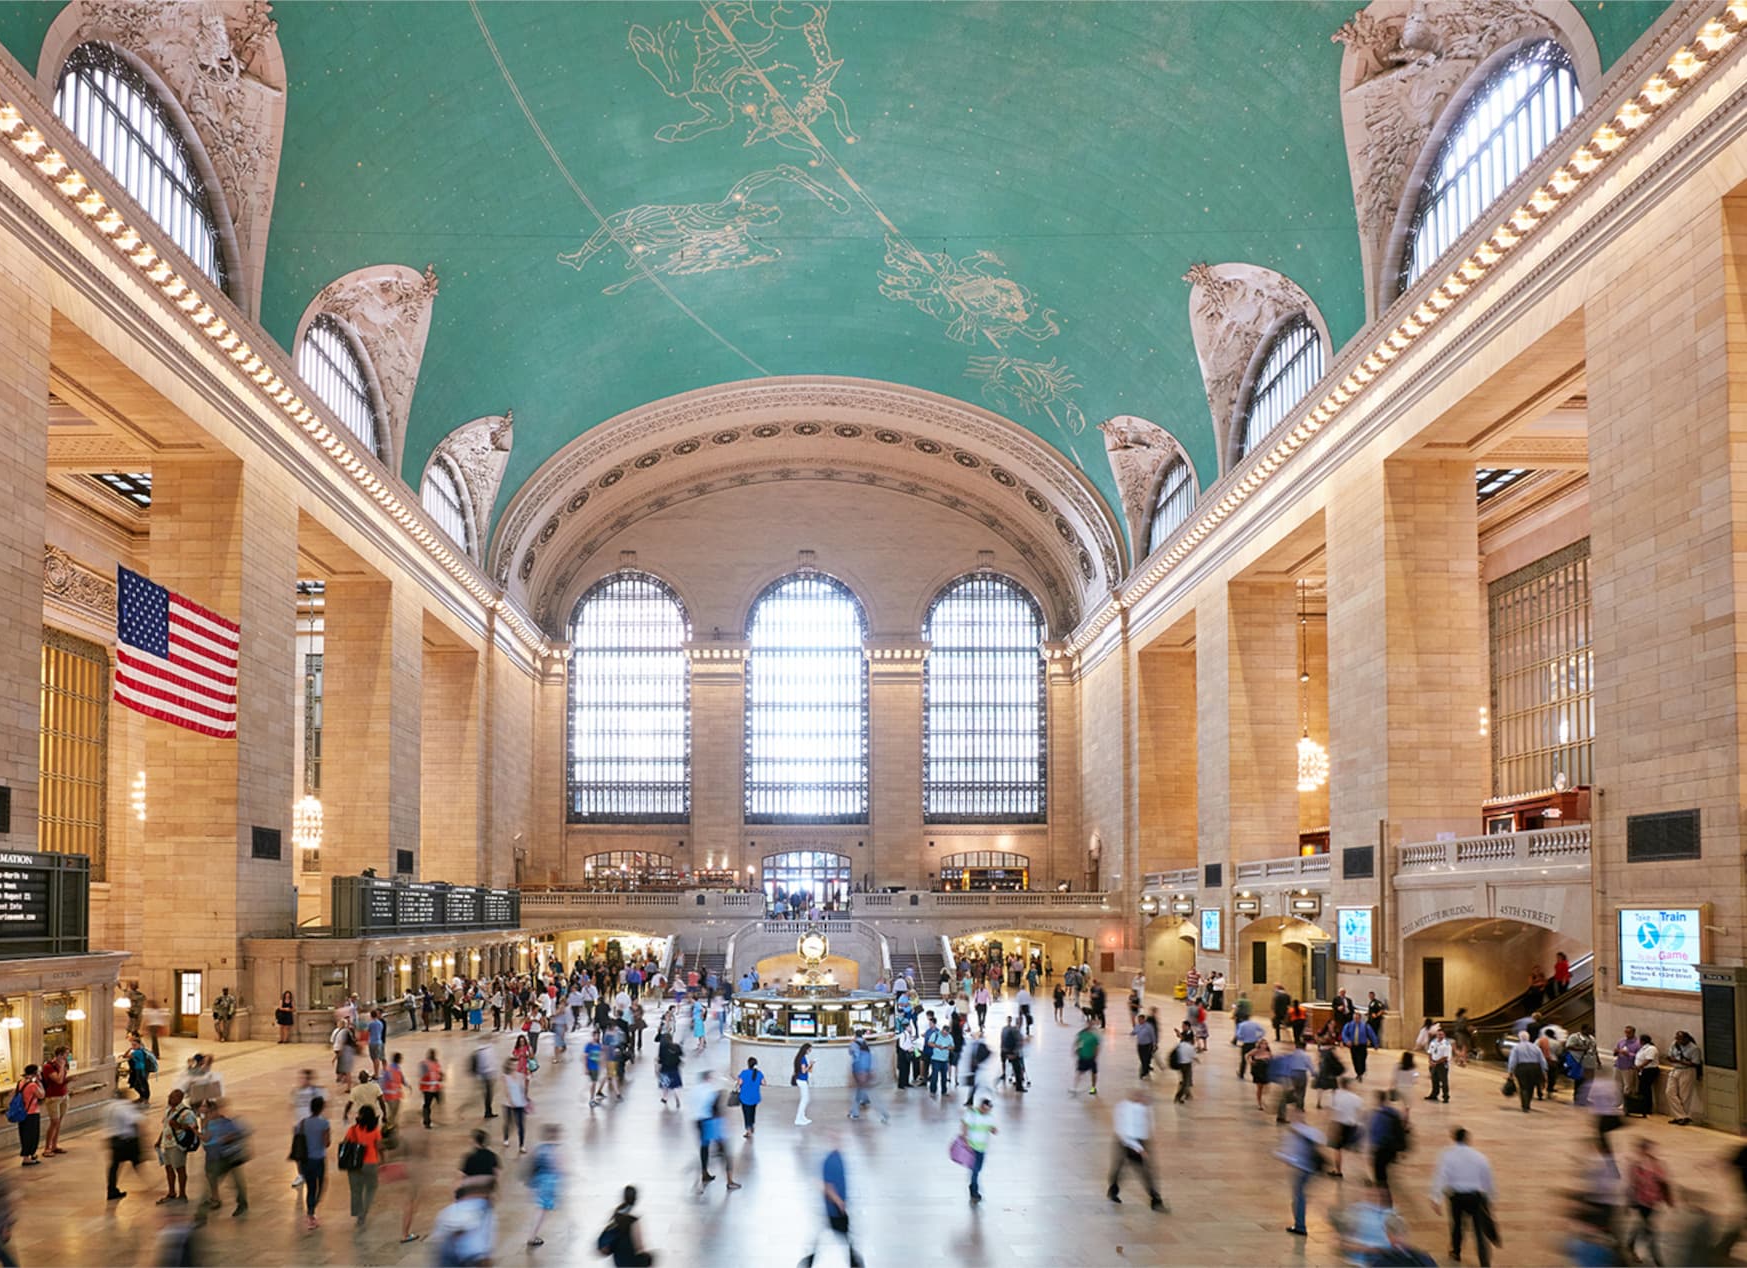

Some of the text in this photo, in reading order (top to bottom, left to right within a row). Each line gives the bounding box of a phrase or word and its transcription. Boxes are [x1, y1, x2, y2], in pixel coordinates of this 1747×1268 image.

[1441, 904, 1476, 919] BUILDING
[1500, 905, 1556, 924] 45TH STREET
[1659, 911, 1687, 921] Train
[1659, 951, 1688, 960] Game
